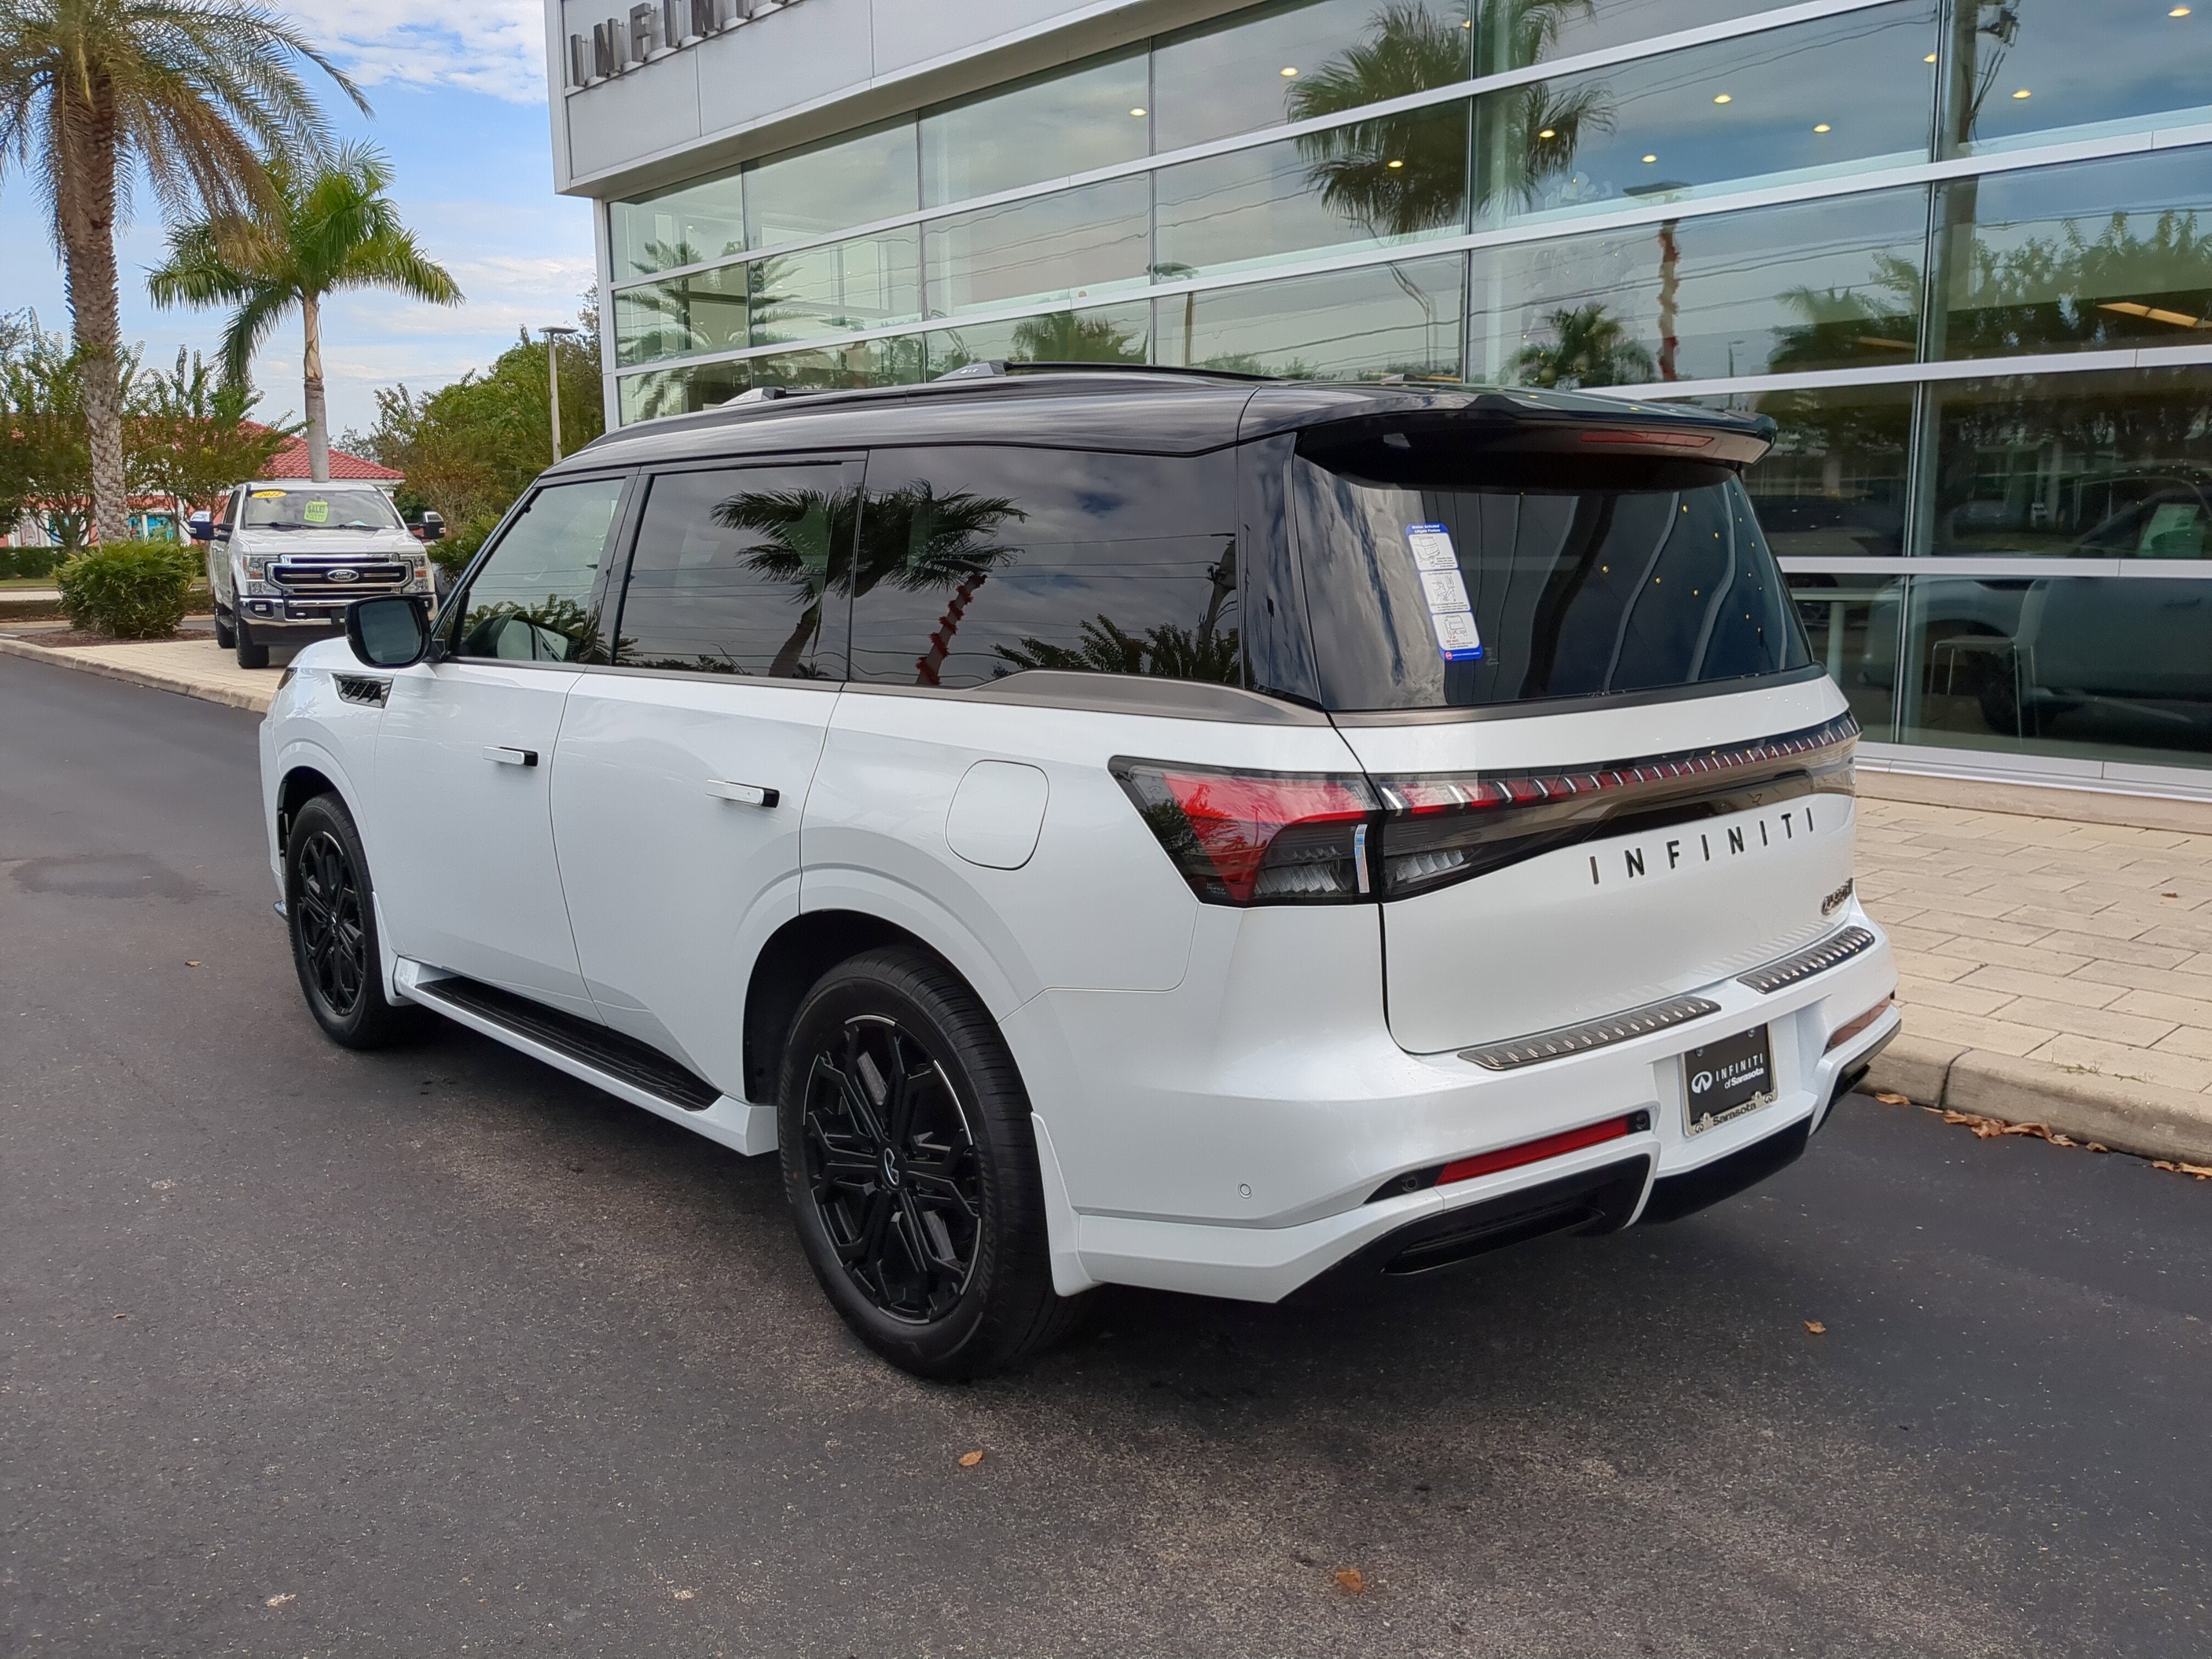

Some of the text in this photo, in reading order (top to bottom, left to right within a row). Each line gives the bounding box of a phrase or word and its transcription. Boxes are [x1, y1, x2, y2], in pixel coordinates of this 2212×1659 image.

[571, 0, 786, 87] INFIN
[1589, 807, 1813, 885] INFINITI
[1716, 1053, 1763, 1082] INFINITI
[1731, 1067, 1764, 1086] Sarasota
[1713, 1102, 1757, 1126] Sarasota
